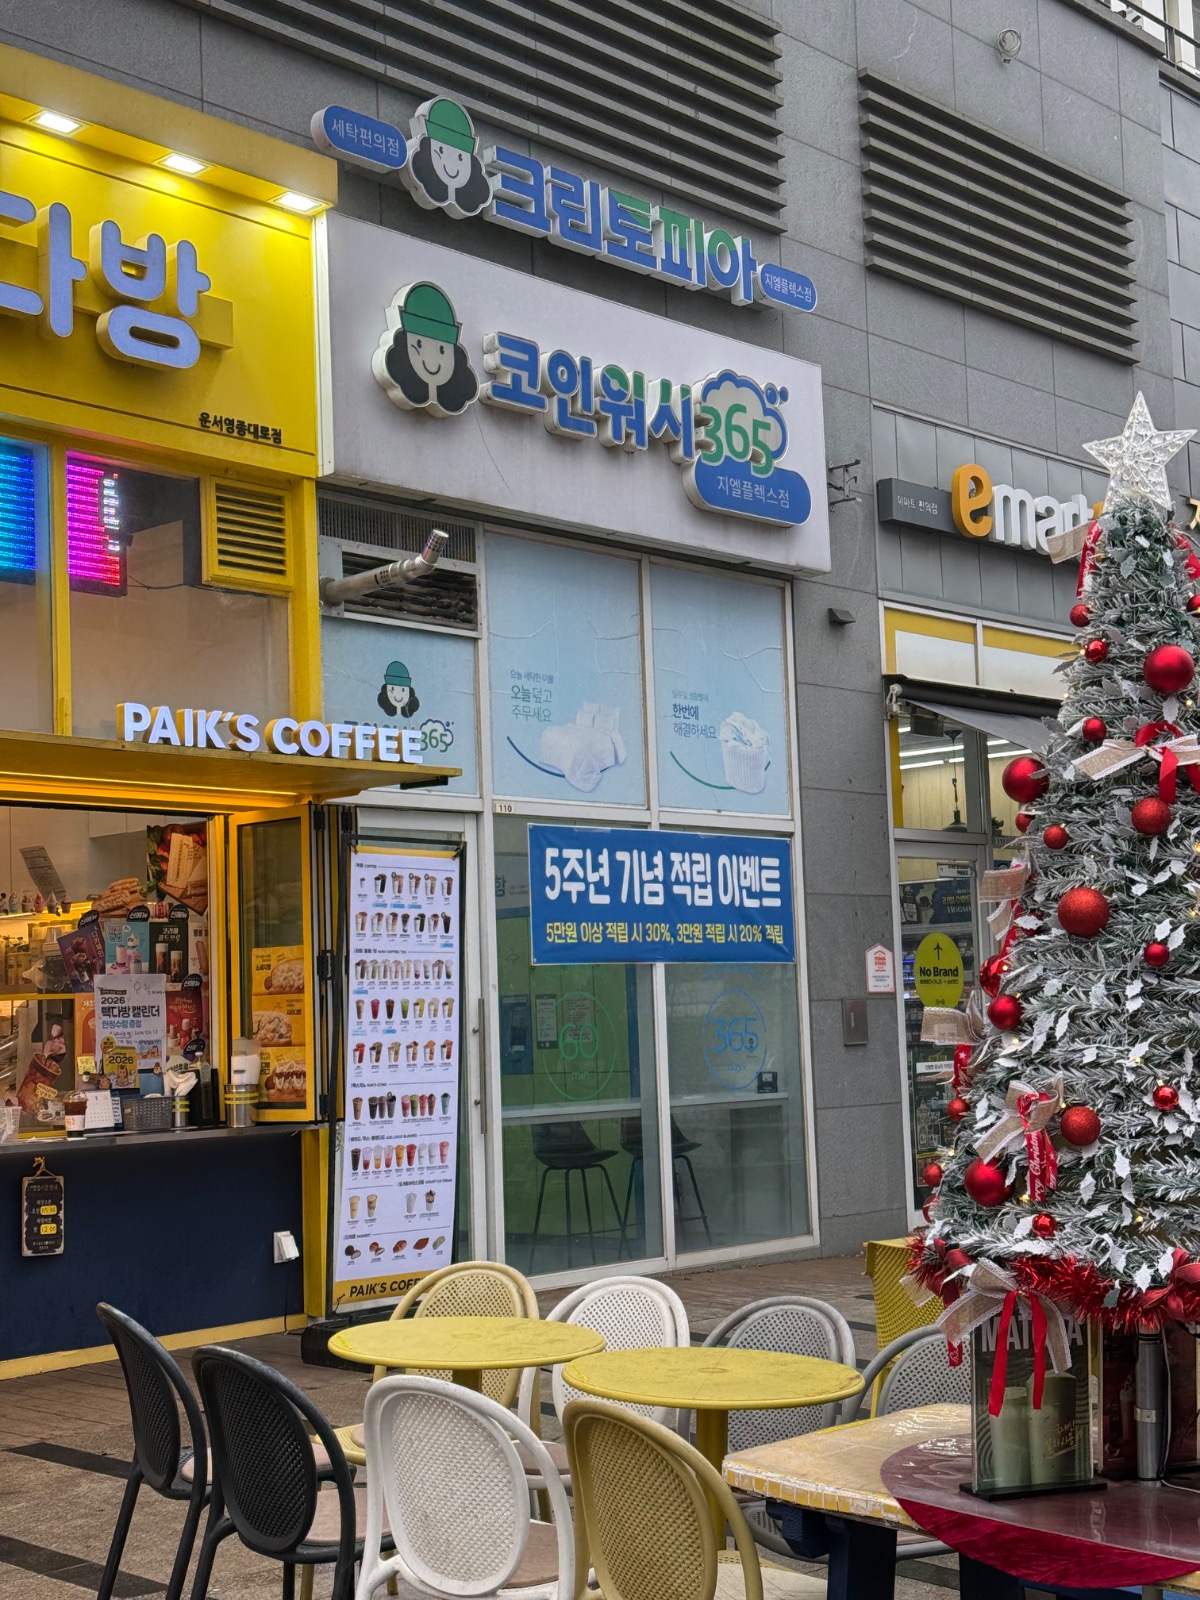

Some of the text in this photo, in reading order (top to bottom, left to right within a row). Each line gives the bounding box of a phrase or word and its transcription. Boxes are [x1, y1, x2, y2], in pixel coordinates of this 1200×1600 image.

[330, 116, 401, 158] 세탁편의점
[490, 146, 758, 306] 크린토피아
[763, 272, 814, 304] 지엘플렉스점
[488, 332, 774, 480] 코인워시 365
[198, 411, 283, 445] 운서영종대로점
[716, 473, 791, 510] 지엘플렉스점
[896, 494, 938, 515] 이마트 편의점
[511, 703, 553, 723] 주무세요
[672, 702, 699, 721] 한번에
[122, 702, 424, 764] PAIK'S COFFEE
[673, 720, 717, 740] 해결하세요
[420, 731, 449, 753] 365
[498, 804, 512, 813] 110
[545, 847, 782, 908] 5주년 기념 적립 이벤트
[546, 921, 784, 945] 5만원 이상 적립 시 30%, 3만원 적립 시 20% 적립
[919, 965, 959, 978] No Brand
[101, 996, 126, 1005] 2026
[101, 1006, 131, 1018] 빽다방
[132, 1004, 160, 1018] 캘린더
[102, 1019, 142, 1029] 한정수량 증정
[711, 1017, 759, 1053] 365
[558, 1023, 600, 1061] 60
[108, 1055, 134, 1065] 2026
[727, 1062, 746, 1073] days
[349, 1277, 424, 1298] PAIK'S COFF
[981, 1315, 1084, 1353] MATA
